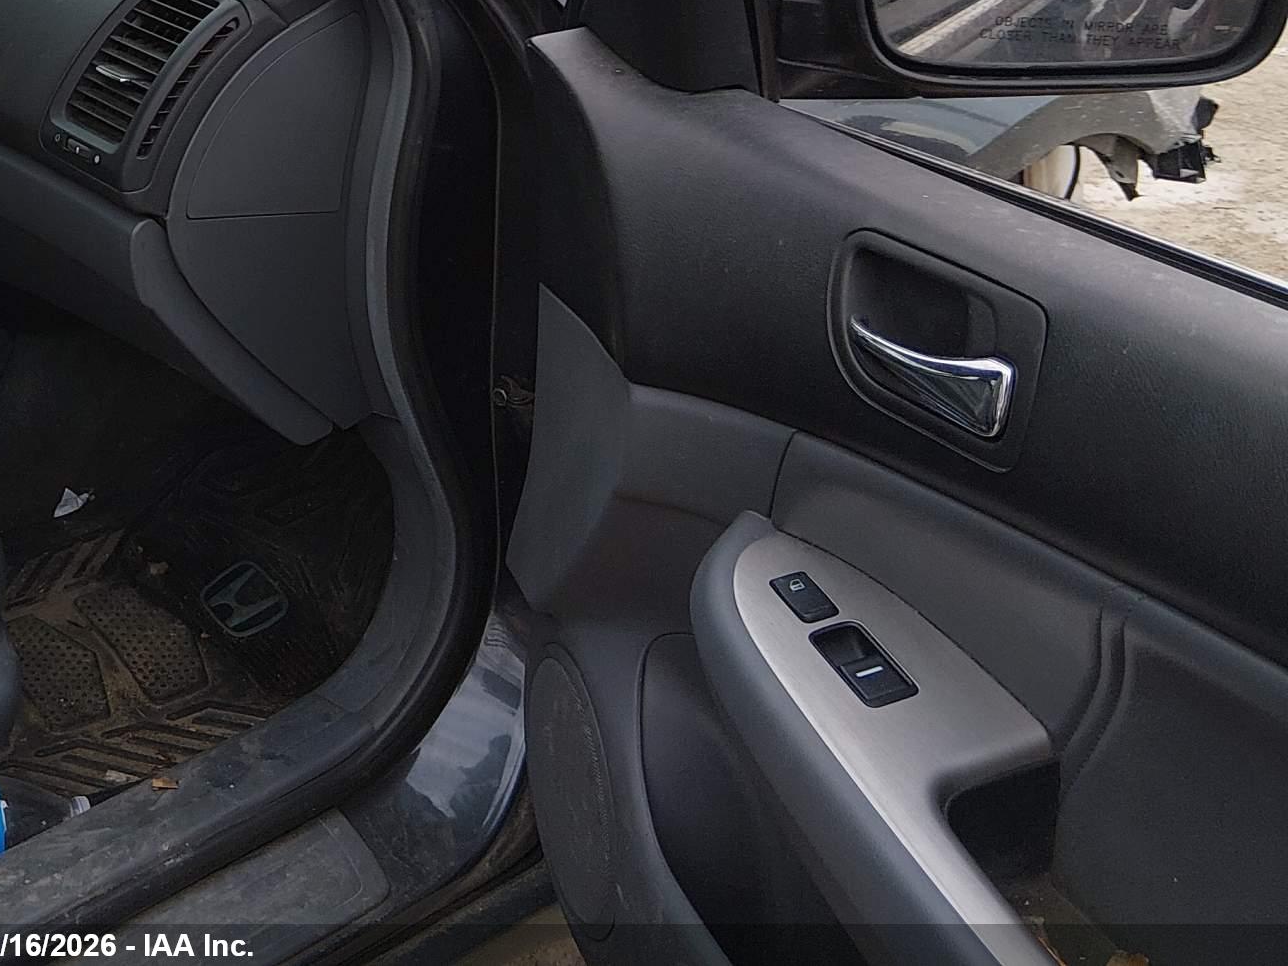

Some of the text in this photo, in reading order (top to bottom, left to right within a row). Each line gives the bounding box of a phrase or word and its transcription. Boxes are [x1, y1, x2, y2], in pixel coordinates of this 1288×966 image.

[994, 16, 1052, 29] OBJECTS
[1084, 20, 1133, 33] MIRROR
[1142, 23, 1169, 36] ARE
[980, 28, 1033, 42] CLOSER
[1086, 33, 1120, 47] THEY
[1127, 36, 1181, 50] APPEAR
